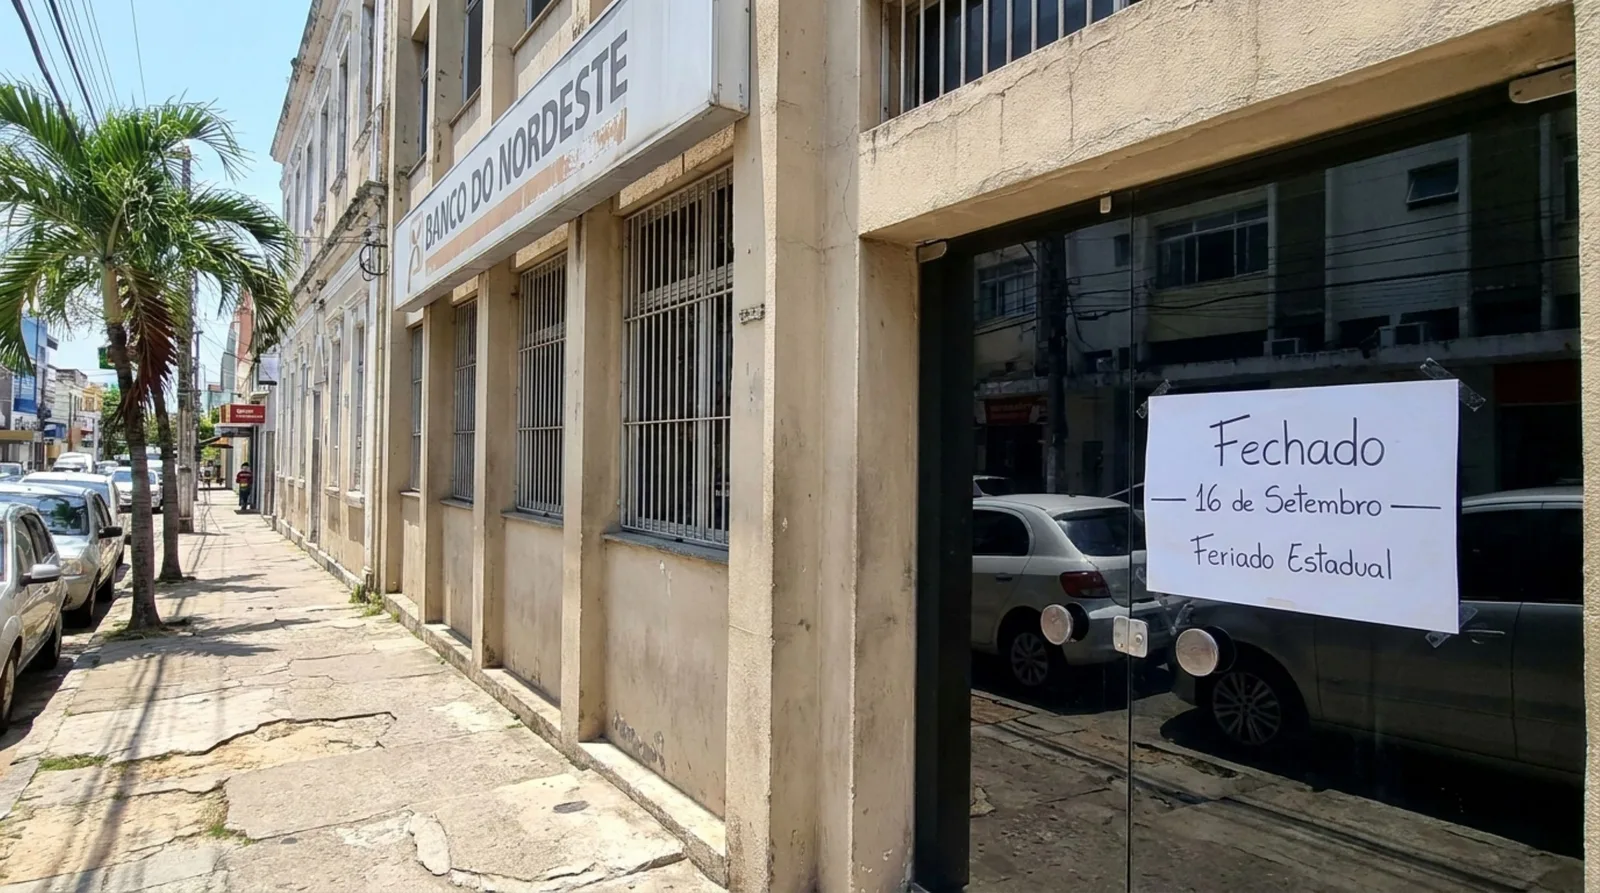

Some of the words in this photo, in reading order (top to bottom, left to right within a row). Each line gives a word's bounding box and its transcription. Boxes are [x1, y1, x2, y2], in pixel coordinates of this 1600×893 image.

[425, 181, 467, 251] BANCO
[470, 156, 494, 214] DO
[499, 29, 628, 192] NORDESTE
[1209, 413, 1385, 467] Fechado
[1195, 483, 1222, 512] 16
[1231, 488, 1255, 512] de
[1264, 483, 1382, 517] Setembro
[1190, 532, 1274, 570] Feriado
[1287, 542, 1392, 580] Estadual
